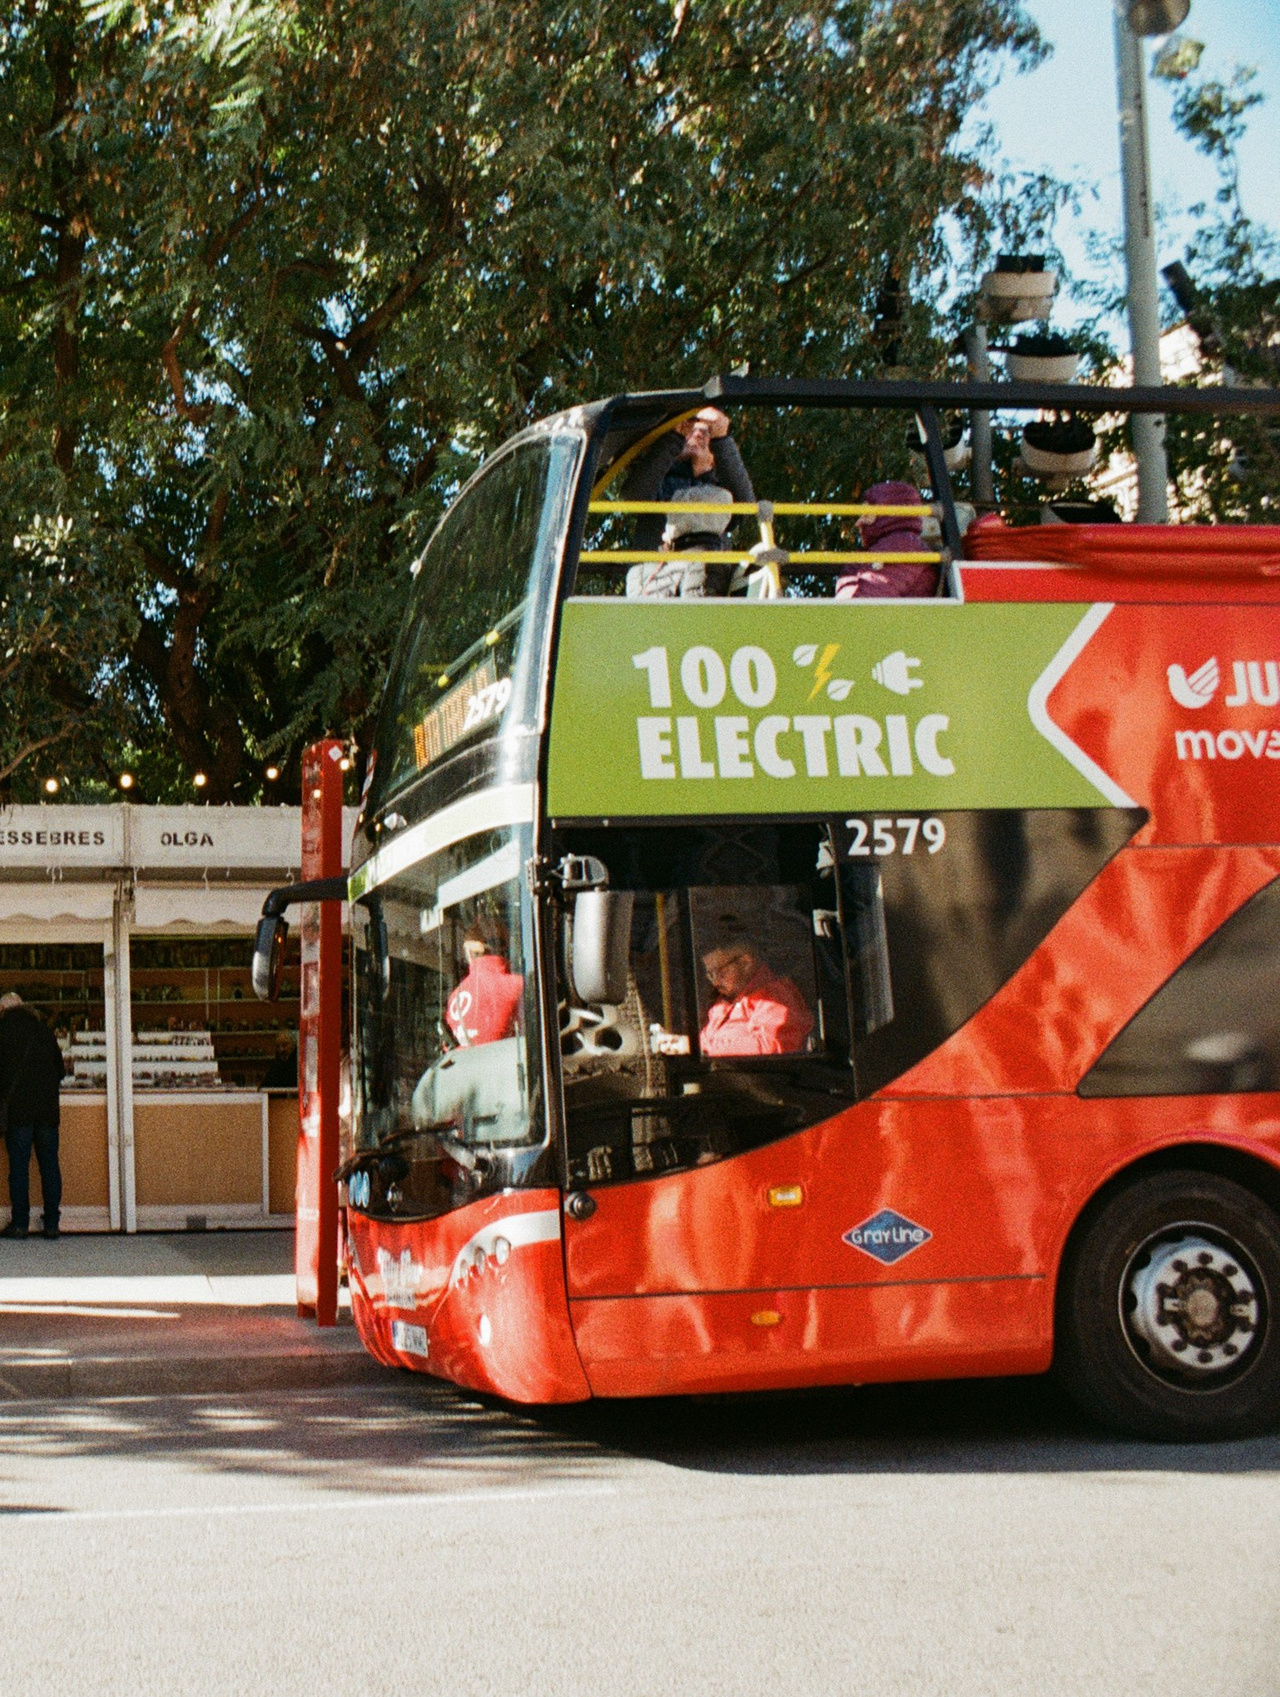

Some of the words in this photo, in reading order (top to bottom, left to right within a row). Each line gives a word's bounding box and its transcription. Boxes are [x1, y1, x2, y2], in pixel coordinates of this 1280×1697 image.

[636, 713, 956, 779] ELECTRIC
[160, 832, 214, 846] OLGA
[845, 818, 946, 856] 2579
